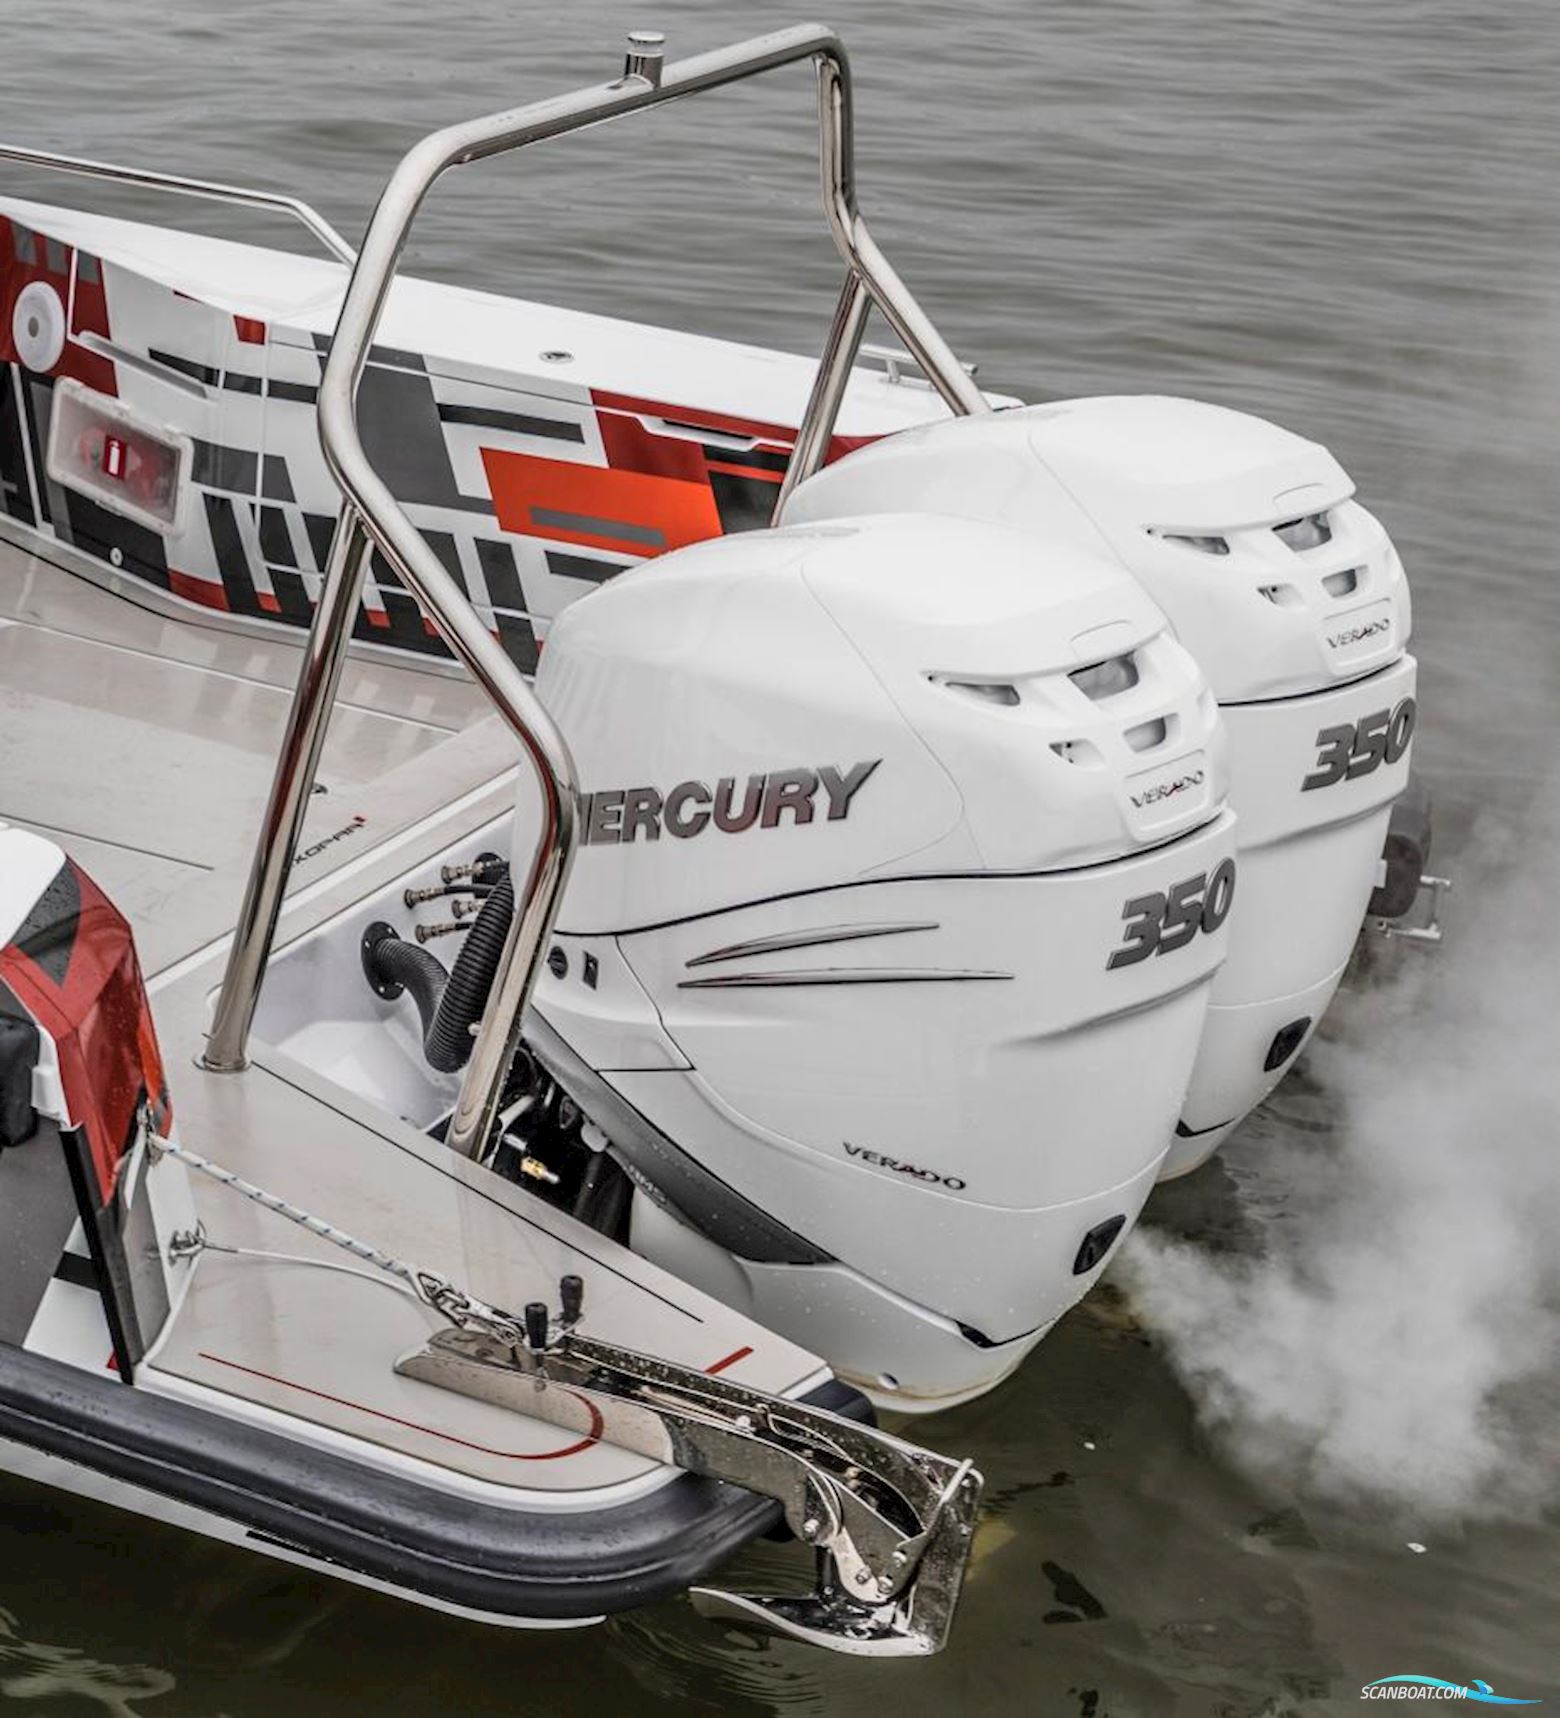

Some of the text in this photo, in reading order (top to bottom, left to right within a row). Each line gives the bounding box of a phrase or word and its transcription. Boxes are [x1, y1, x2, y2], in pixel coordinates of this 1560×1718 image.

[1326, 618, 1390, 648] VERADO
[1300, 696, 1416, 792] 350
[1129, 770, 1205, 808] VERADO
[1106, 857, 1236, 971] 350
[843, 1141, 967, 1190] VERADO
